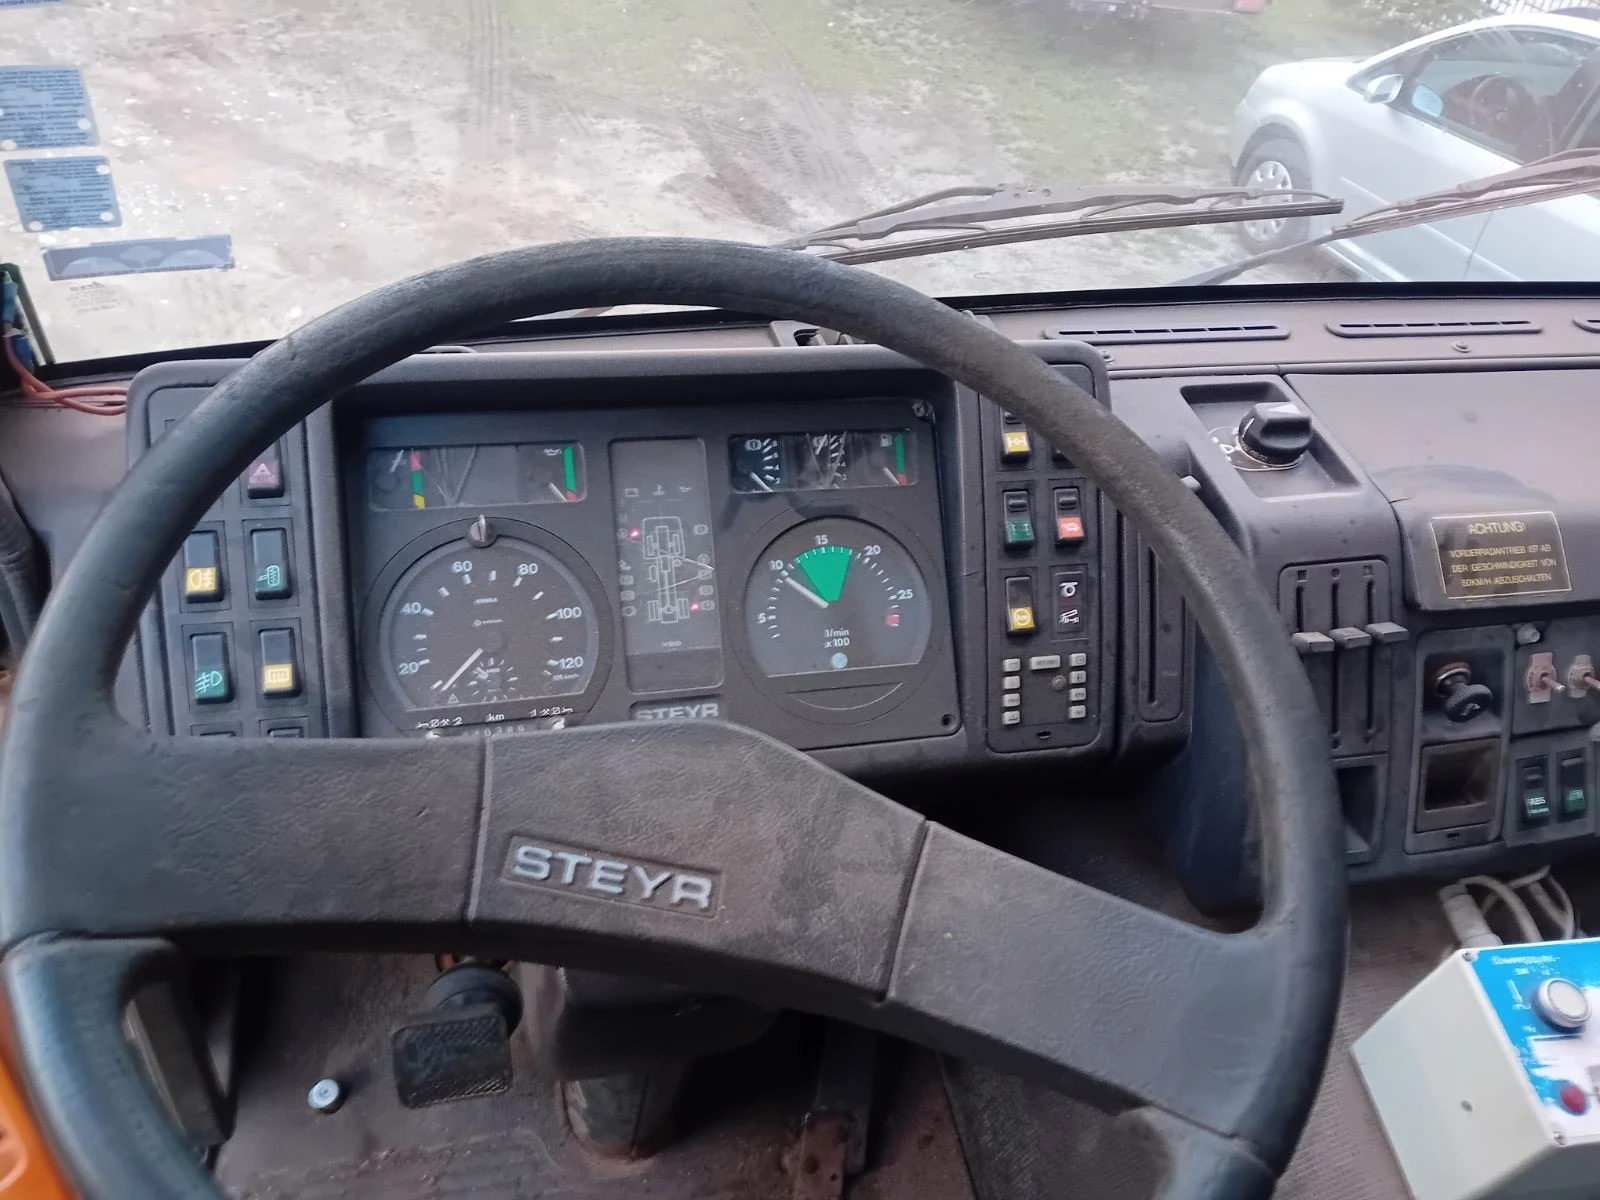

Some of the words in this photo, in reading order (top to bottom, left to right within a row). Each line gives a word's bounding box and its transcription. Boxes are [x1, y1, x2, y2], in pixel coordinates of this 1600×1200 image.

[1469, 521, 1526, 535] ACHTUNG!
[816, 535, 829, 545] 15
[865, 544, 882, 556] 20
[1450, 546, 1526, 557] VORDERRADANTRIEB
[1529, 544, 1539, 553] IST
[1541, 543, 1551, 552] AB
[453, 560, 472, 573] 60
[519, 563, 539, 576] 80
[770, 559, 784, 571] 10
[1452, 564, 1468, 573] DER
[1471, 559, 1538, 571] GESCHWINDIGKEIT
[1541, 558, 1557, 567] VON
[1494, 573, 1552, 584] ABZUSCHALTEN
[898, 588, 914, 600] 25
[402, 602, 422, 614] 40
[556, 606, 583, 619] 100
[757, 613, 767, 624] 5
[400, 661, 420, 674] 20
[559, 656, 584, 669] 120
[636, 702, 719, 720] STEYR
[453, 716, 463, 727] 2
[488, 713, 505, 722] km
[1528, 796, 1546, 806] ABS
[513, 845, 712, 909] STEYR
